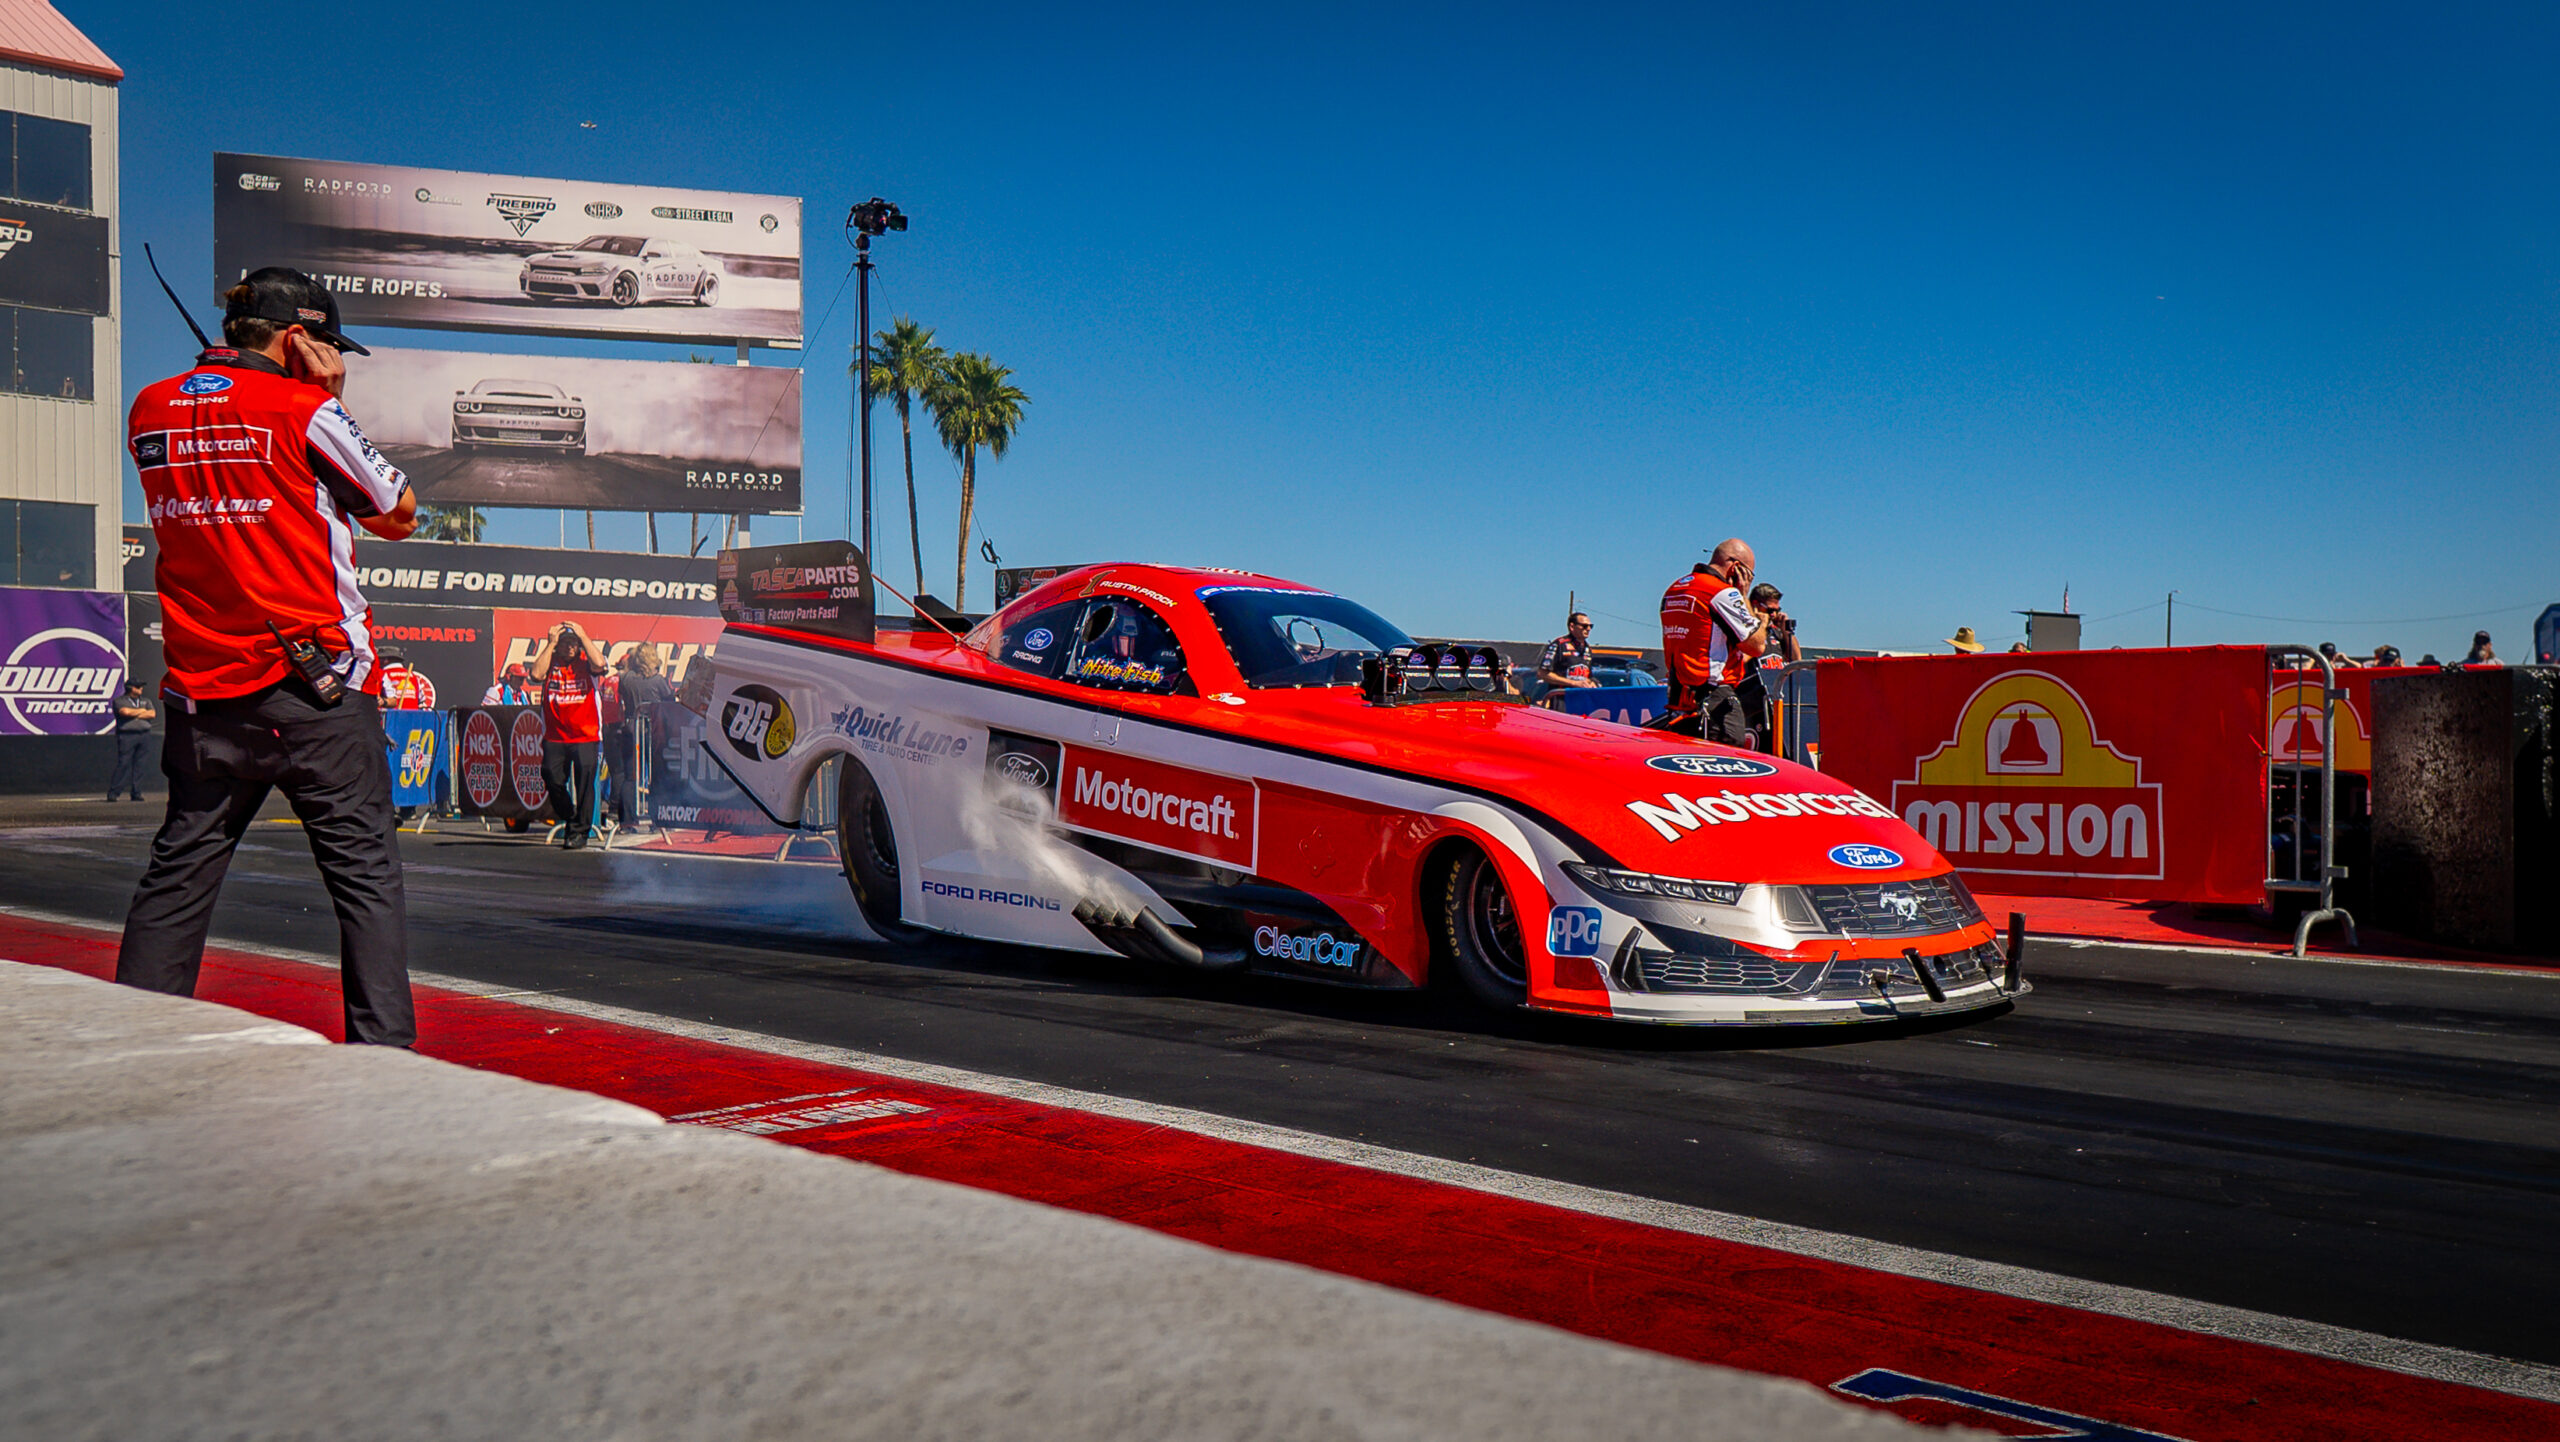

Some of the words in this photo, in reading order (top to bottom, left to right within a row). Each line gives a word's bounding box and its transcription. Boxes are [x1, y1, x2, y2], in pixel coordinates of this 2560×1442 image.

[304, 177, 392, 194] RADFORD
[486, 197, 556, 211] FIREBIRD
[588, 202, 620, 218] NHRA
[676, 208, 706, 221] STREET
[707, 211, 733, 223] LEGAL
[323, 274, 364, 294] THE
[371, 277, 448, 298] ROPES.
[646, 272, 696, 283] RADFORD
[169, 395, 230, 407] RACING
[177, 436, 259, 455] Motorcraft
[686, 470, 783, 485] RADFORD
[686, 482, 730, 490] RACING
[738, 483, 783, 492] SCHOOL
[165, 495, 214, 519] Quick
[215, 495, 273, 512] Lane
[355, 567, 438, 590] HOME
[444, 571, 505, 592] FOR
[510, 574, 717, 602] MOTORSPORTS
[830, 587, 860, 598] .COM
[1100, 580, 1140, 593] AUSTIN
[1139, 587, 1178, 608] PROCK
[767, 608, 796, 622] Factory
[796, 607, 817, 620] Parts
[818, 606, 839, 619] Fast!
[1012, 650, 1043, 664] RACING
[1124, 661, 1162, 684] Fish
[25, 699, 113, 714] motors.
[729, 698, 773, 744] BG
[845, 706, 905, 745] Quick
[904, 720, 968, 758] Lane
[469, 733, 496, 756] NGK
[515, 734, 544, 756] NGK
[861, 738, 879, 752] TIRE
[886, 745, 906, 760] AUTO
[470, 763, 496, 776] SPARK
[518, 766, 543, 778] SPAR
[1002, 755, 1040, 786] Ford
[1672, 756, 1758, 776] Ford
[470, 777, 497, 790] PLUGS
[519, 780, 546, 793] PLUGS
[1626, 788, 1900, 844] Motorcraf
[1905, 799, 2148, 859] MISSION
[1843, 847, 1893, 867] Ford
[921, 880, 975, 900] FORD
[978, 889, 1061, 911] RACING
[1551, 910, 1600, 951] PPG
[1253, 925, 1360, 967] ClearCar
